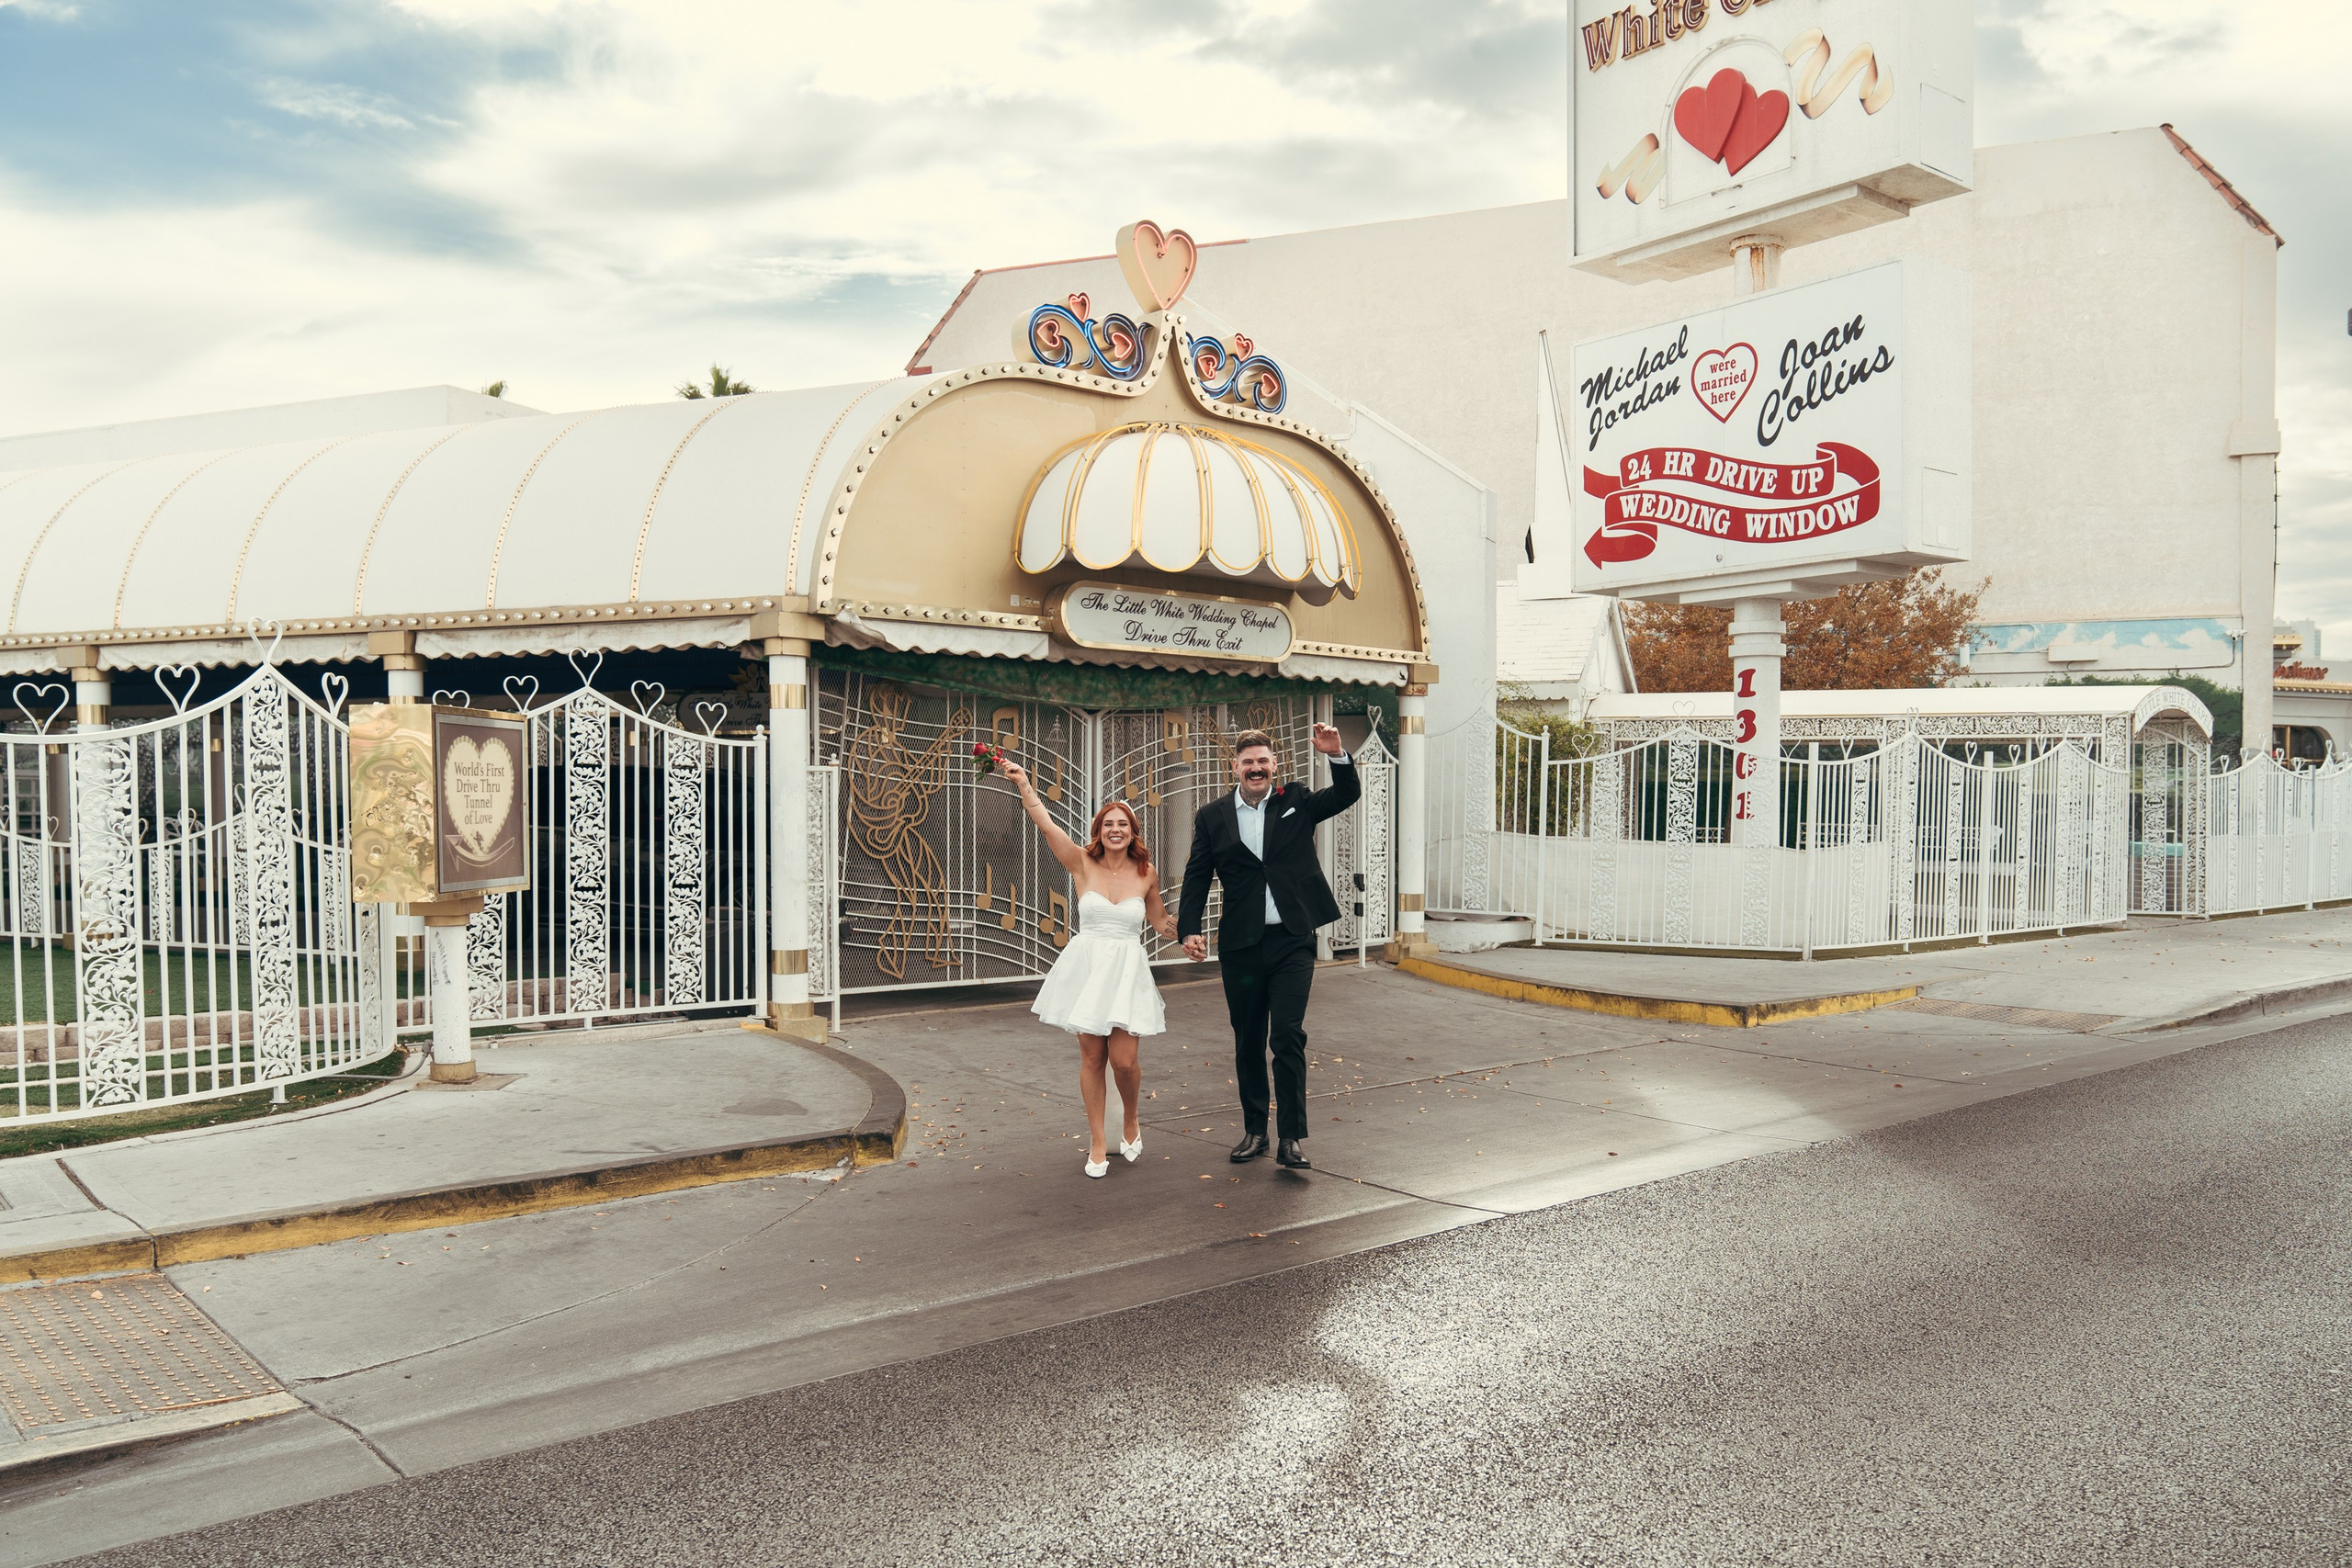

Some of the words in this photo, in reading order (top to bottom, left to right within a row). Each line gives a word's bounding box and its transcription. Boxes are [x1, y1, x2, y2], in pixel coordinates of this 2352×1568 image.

[1581, 0, 1710, 73] White
[1580, 324, 1689, 409] Michael
[1709, 357, 1736, 375] were
[1779, 314, 1866, 401] Joan
[1700, 369, 1747, 392] married
[1710, 389, 1736, 405] here
[1758, 344, 1895, 447] Collins
[1589, 376, 1680, 452] Jordan
[1627, 455, 1652, 480] 24
[1663, 451, 1696, 477] HR
[1705, 456, 1778, 494] DRIVE
[1791, 467, 1825, 495] UP
[1620, 492, 1731, 536] WEDDING
[1745, 494, 1860, 539] WINDOW
[1080, 592, 1109, 611] The
[1113, 594, 1147, 615] Little
[1150, 599, 1185, 619] White
[1188, 604, 1237, 630] Wedding
[1240, 609, 1279, 633] Chapel
[1124, 619, 1168, 644] Drive
[1172, 626, 1211, 648] Thru
[1216, 628, 1243, 651] Exit
[735, 696, 763, 710] White
[2137, 694, 2161, 723] LITTLE
[2162, 692, 2185, 705] WHITE
[2187, 697, 2211, 732] CHAPEL
[454, 761, 484, 777] World's
[486, 762, 504, 777] First
[456, 778, 478, 793] Drive
[480, 778, 501, 793] Thru
[464, 794, 492, 808] Tunnel
[464, 809, 473, 825] of
[474, 810, 492, 824] Love
